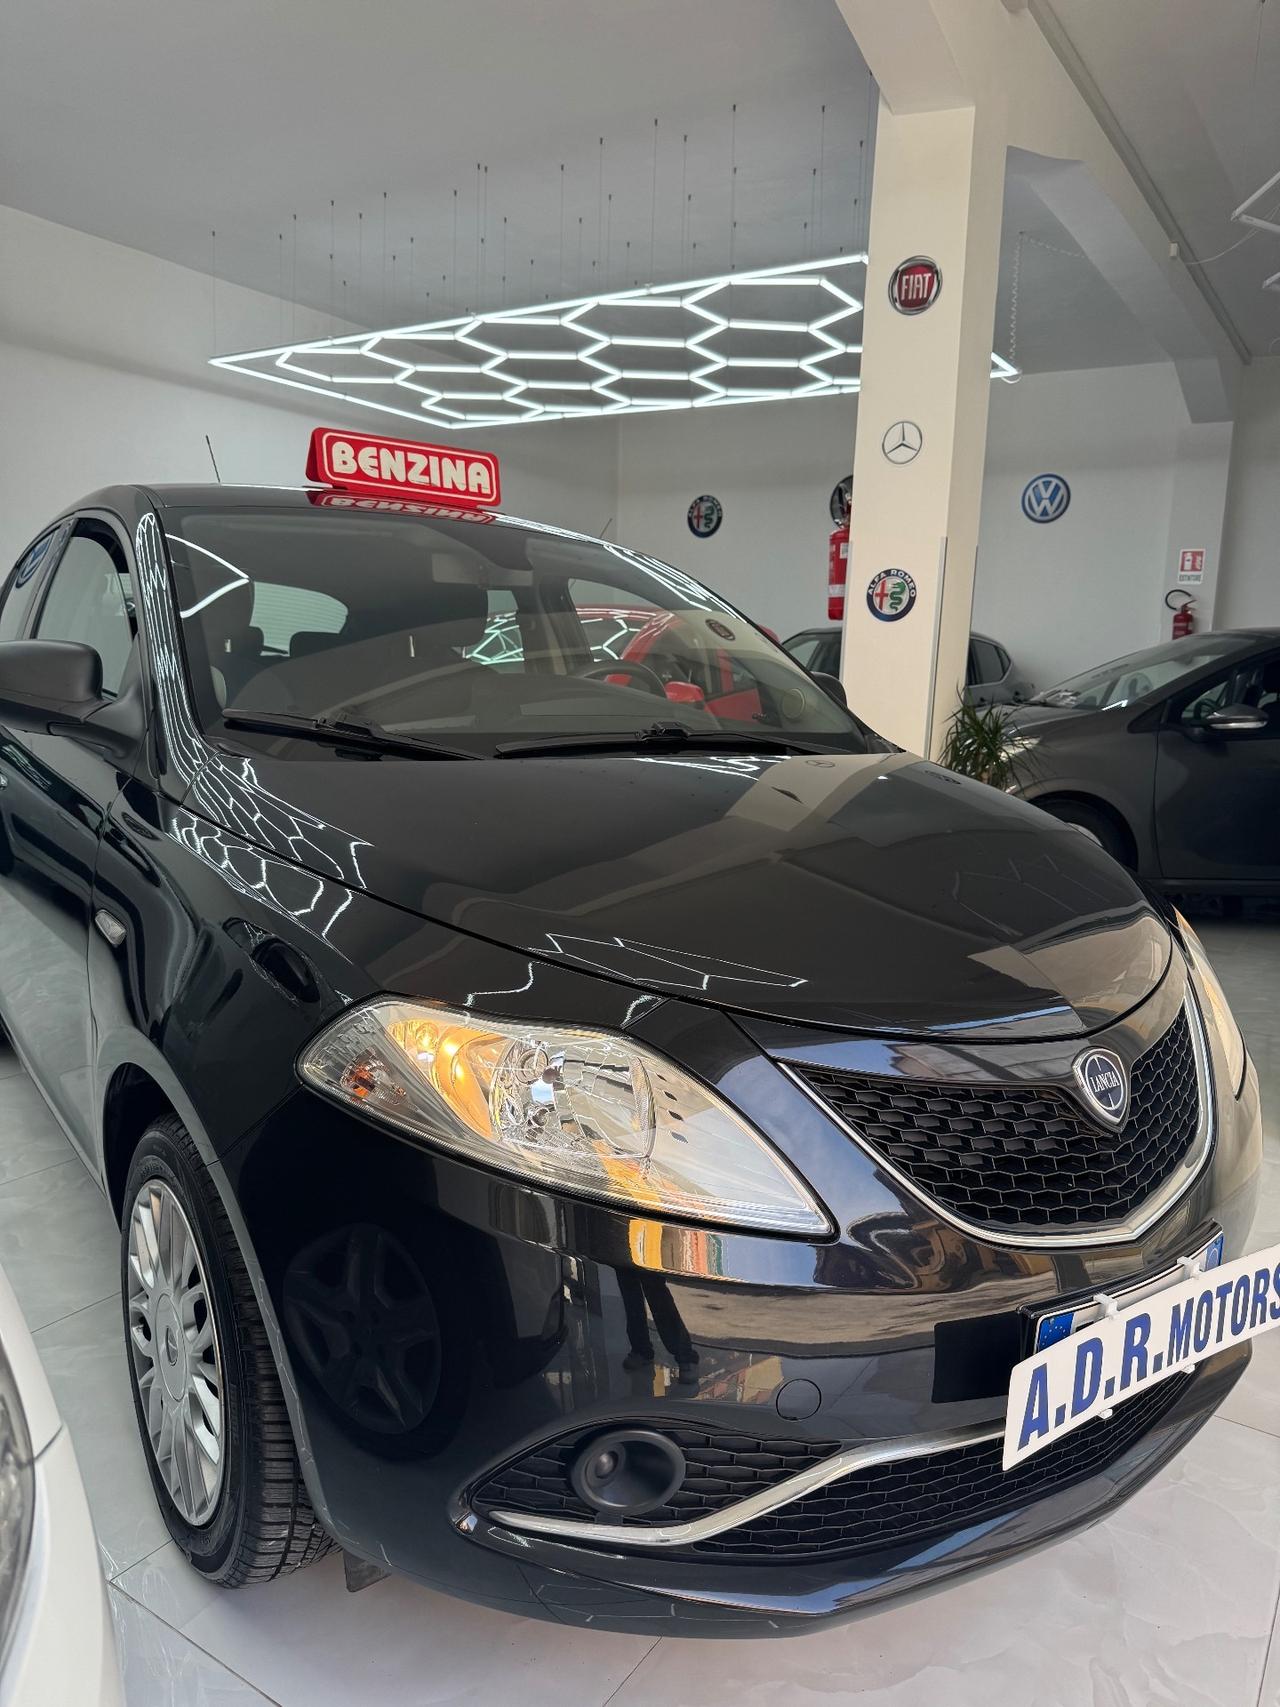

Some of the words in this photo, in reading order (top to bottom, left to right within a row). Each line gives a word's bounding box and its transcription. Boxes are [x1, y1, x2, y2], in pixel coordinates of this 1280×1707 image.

[901, 273, 932, 300] FIAT
[332, 441, 491, 494] BENZINA
[868, 572, 887, 596] ALFA
[891, 569, 916, 597] ROMEO
[1090, 1071, 1120, 1093] LANCIA
